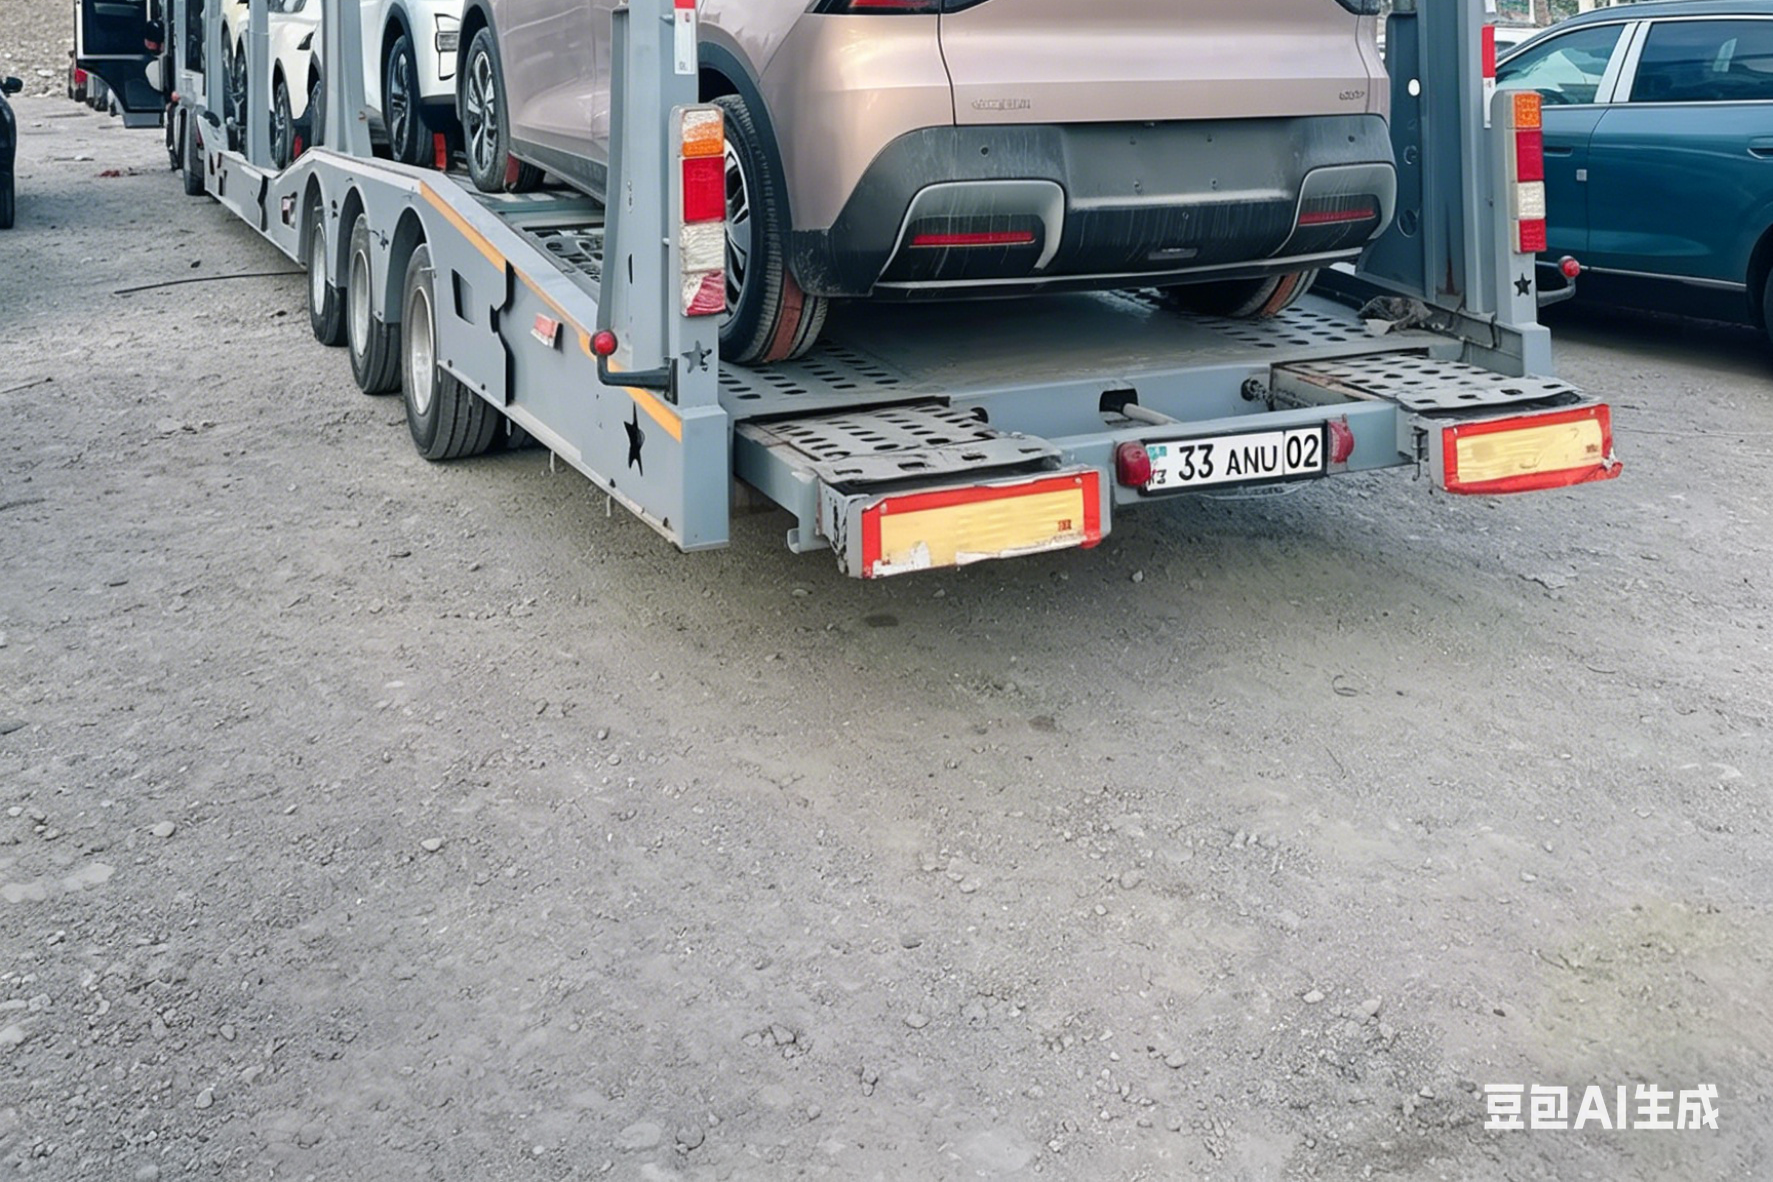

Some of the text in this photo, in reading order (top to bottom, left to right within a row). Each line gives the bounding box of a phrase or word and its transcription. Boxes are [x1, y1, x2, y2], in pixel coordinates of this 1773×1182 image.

[1178, 434, 1319, 480] 33 ANU 02
